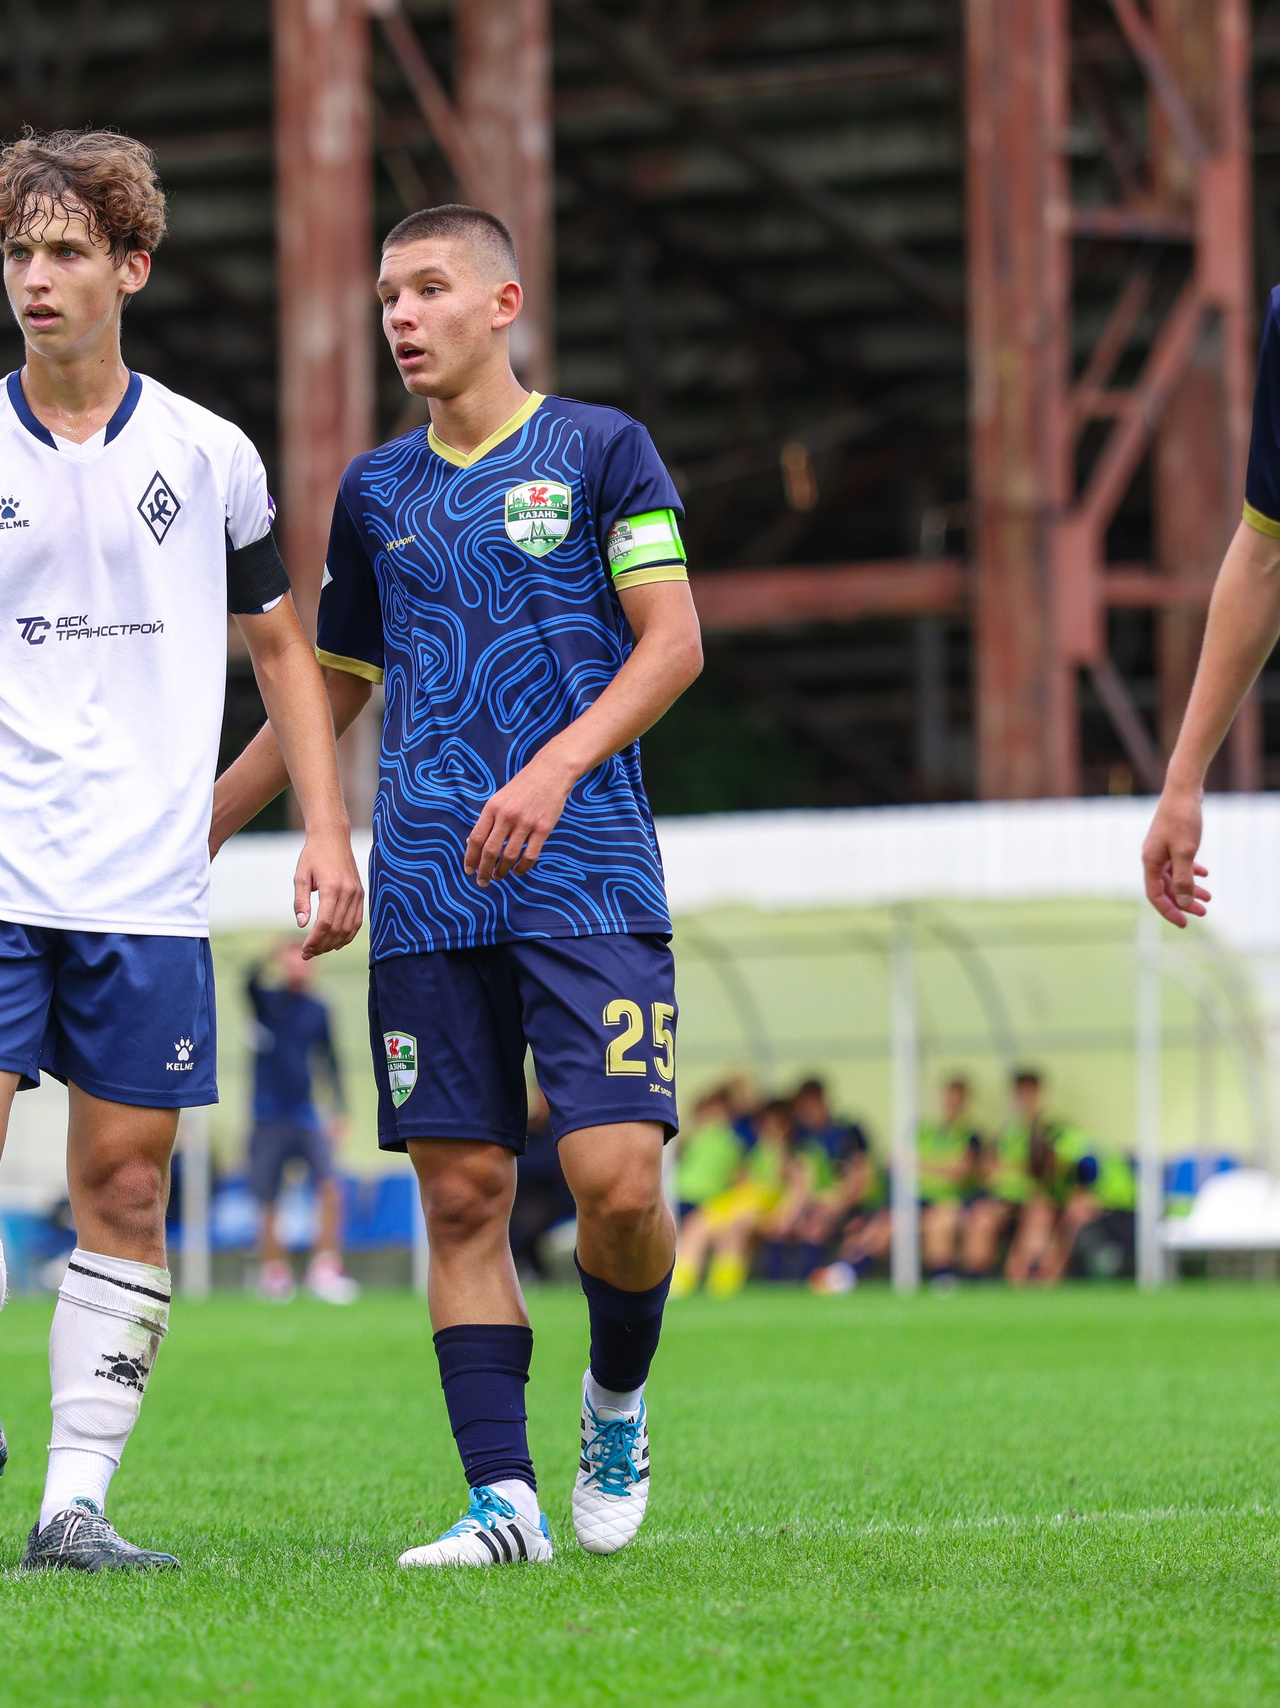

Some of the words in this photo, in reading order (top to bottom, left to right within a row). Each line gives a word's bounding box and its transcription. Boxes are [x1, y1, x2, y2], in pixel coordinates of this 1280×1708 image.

[518, 510, 558, 520] КАЗАНЬ
[394, 534, 417, 548] SPORT
[56, 615, 89, 628] ДСК
[56, 620, 164, 641] ТРАНССТРОЙ
[602, 999, 675, 1082] 25
[166, 1062, 194, 1071] KELME
[95, 1369, 145, 1393] KELME
